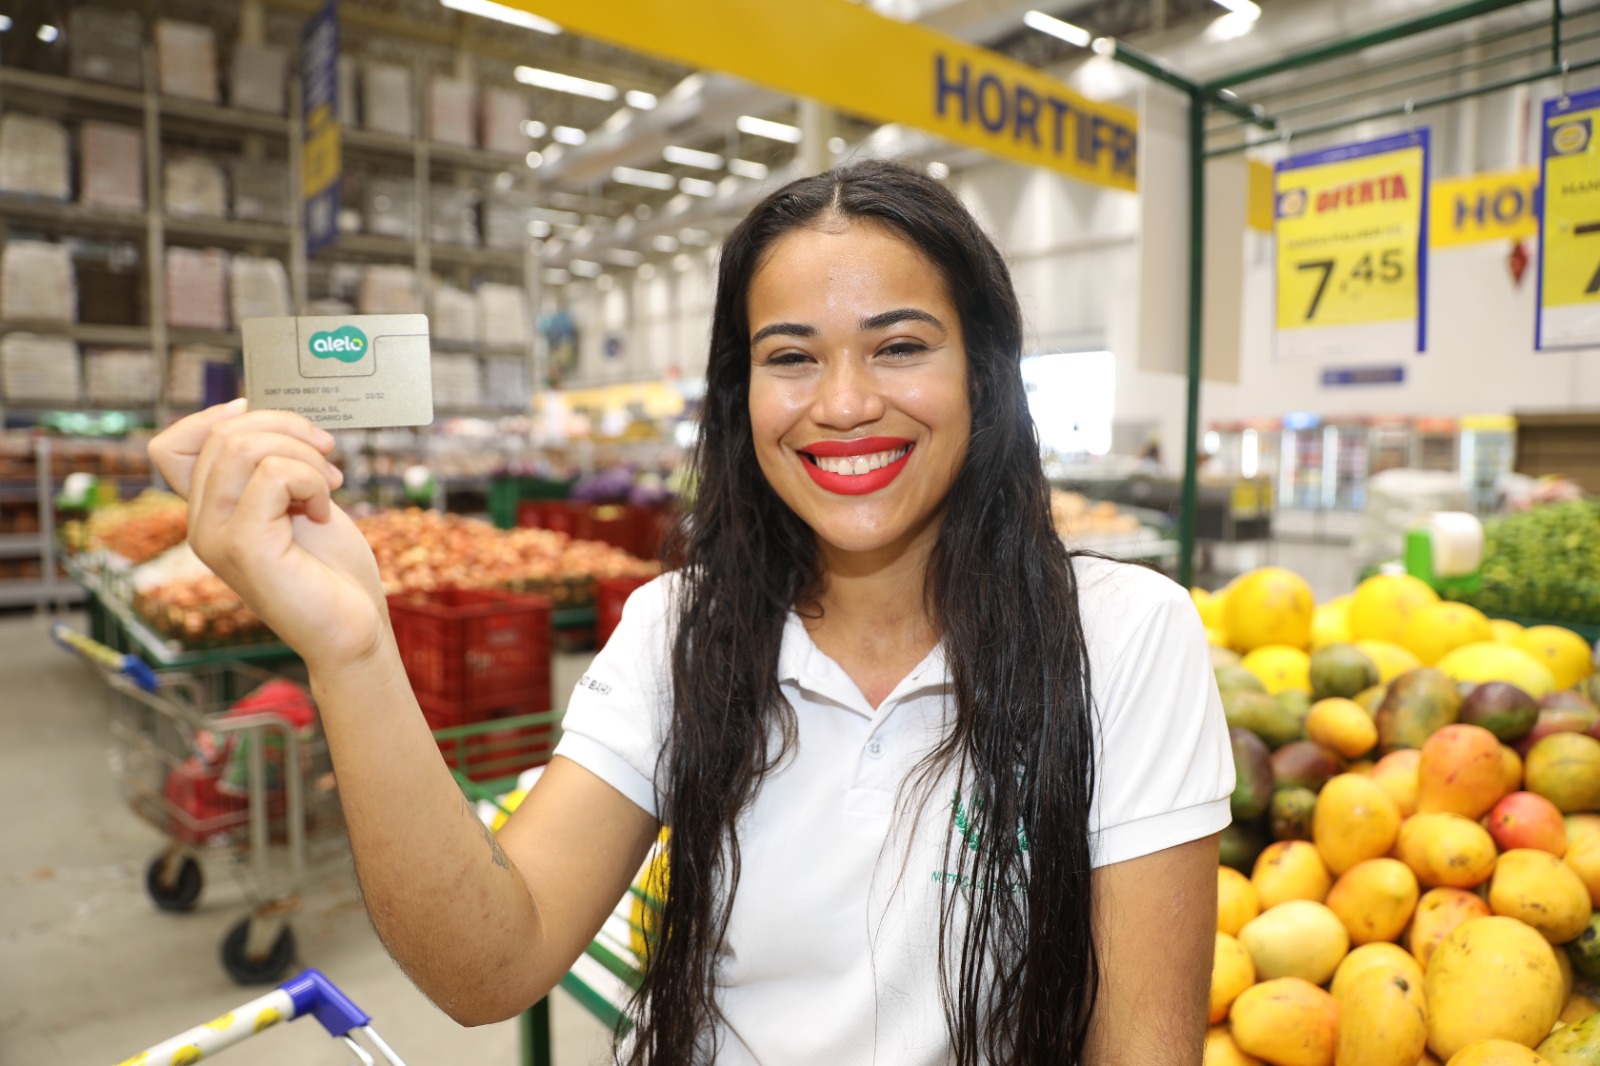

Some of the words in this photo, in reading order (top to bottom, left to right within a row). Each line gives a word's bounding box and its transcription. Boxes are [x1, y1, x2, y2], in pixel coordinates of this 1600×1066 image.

[1316, 174, 1408, 213] OFERTA
[1454, 182, 1541, 232] HO
[313, 335, 364, 353] alelo
